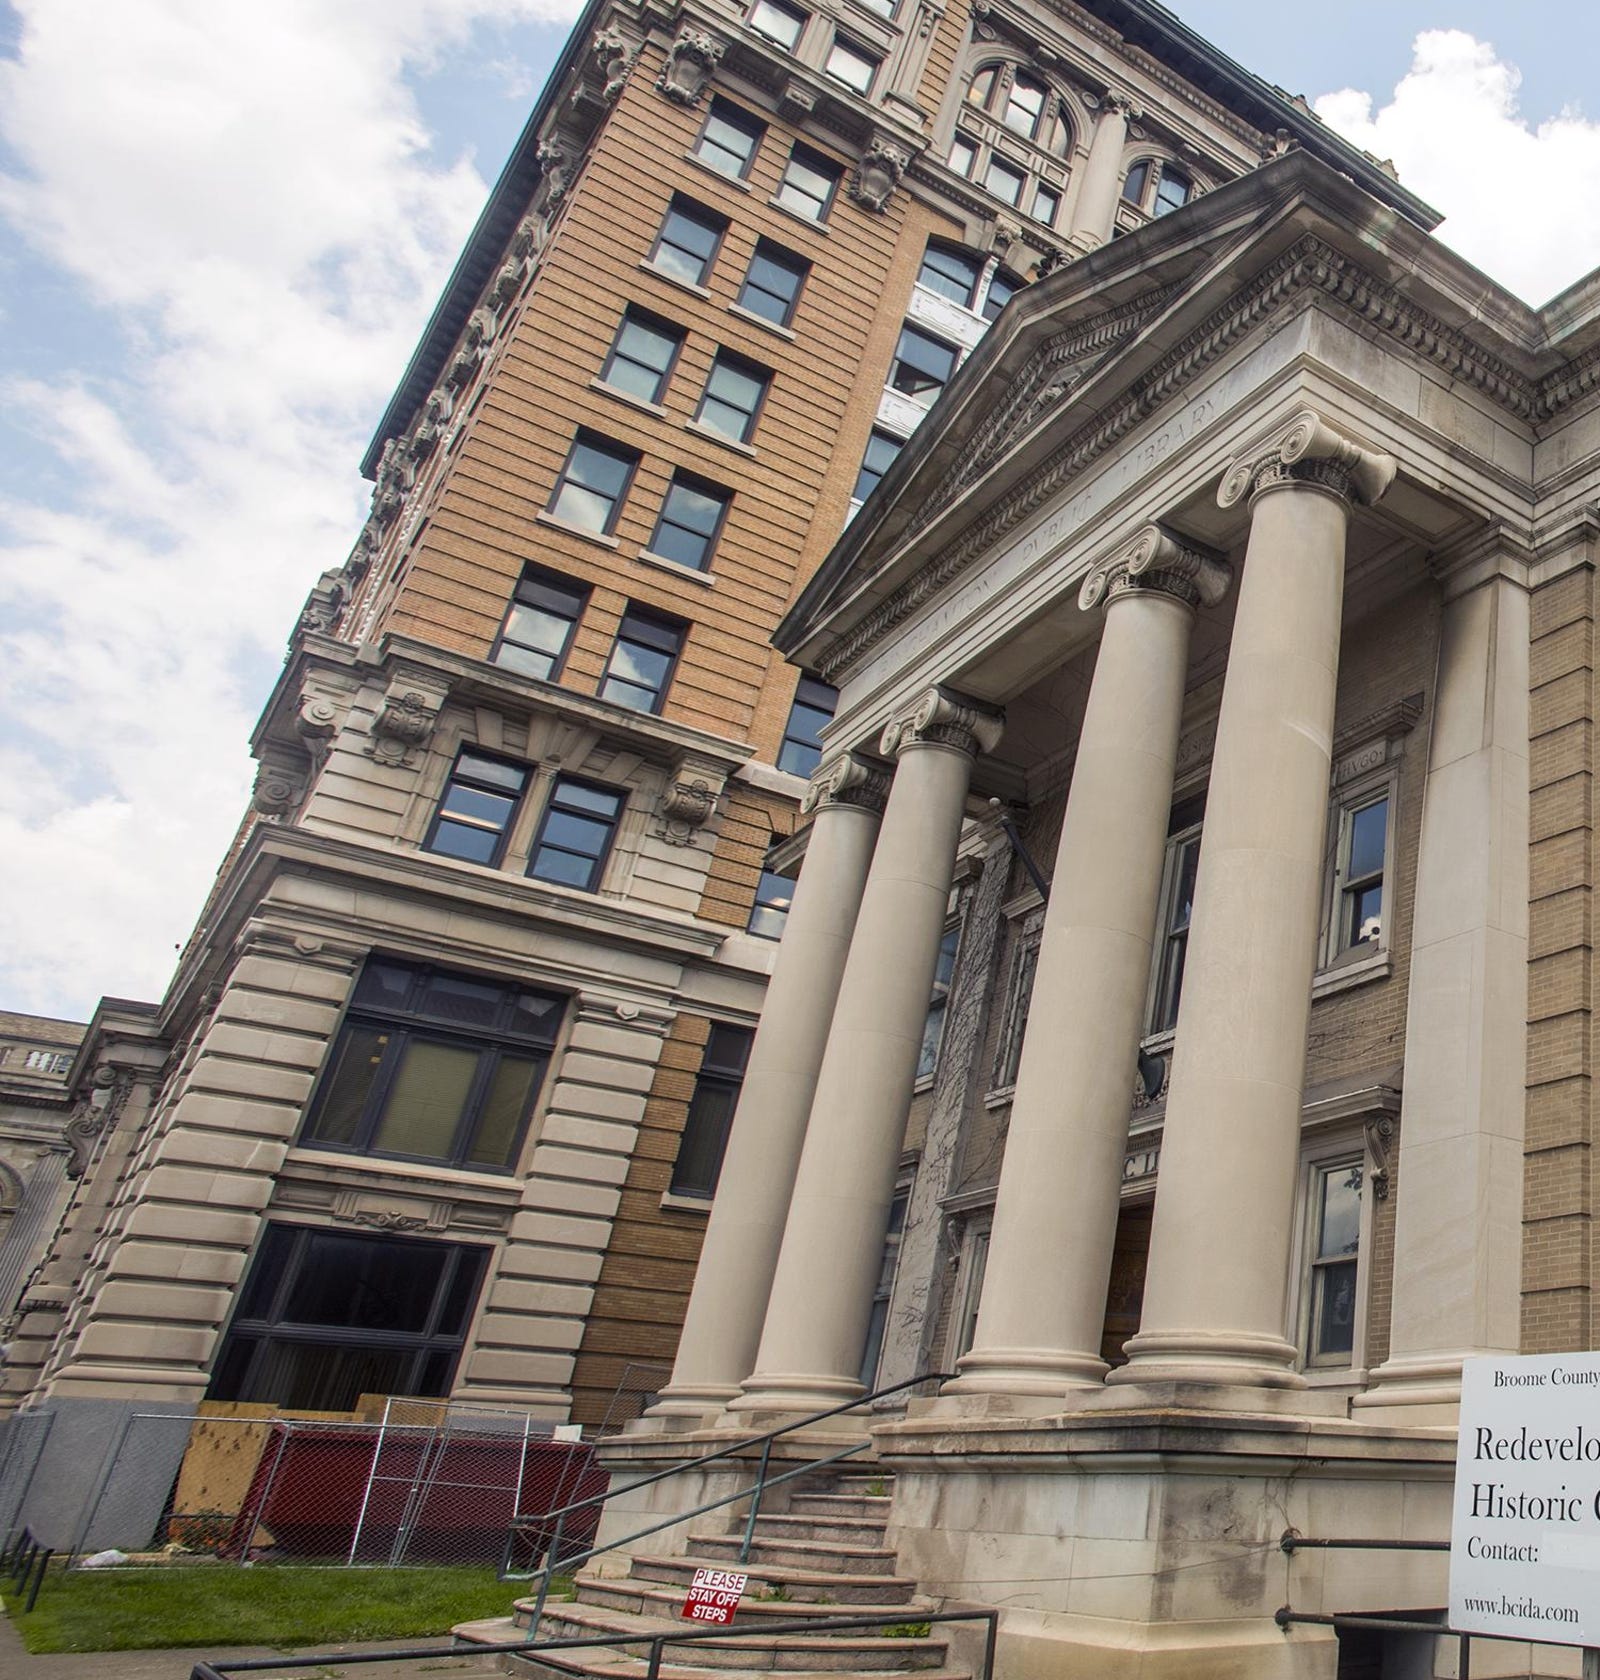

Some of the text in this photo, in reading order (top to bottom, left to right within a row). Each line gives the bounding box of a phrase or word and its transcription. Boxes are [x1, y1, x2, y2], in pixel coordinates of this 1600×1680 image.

[1121, 387, 1224, 484] LIBRARY
[1494, 1370, 1547, 1388] Broome
[1551, 1367, 1600, 1388] County
[1470, 1483, 1583, 1522] Historic
[1467, 1535, 1539, 1562] Contact:
[696, 1570, 744, 1590] PLEASE
[689, 1587, 739, 1607] STAY OFF
[1464, 1595, 1580, 1623] www.bcida.com
[692, 1605, 727, 1622] STEPS
